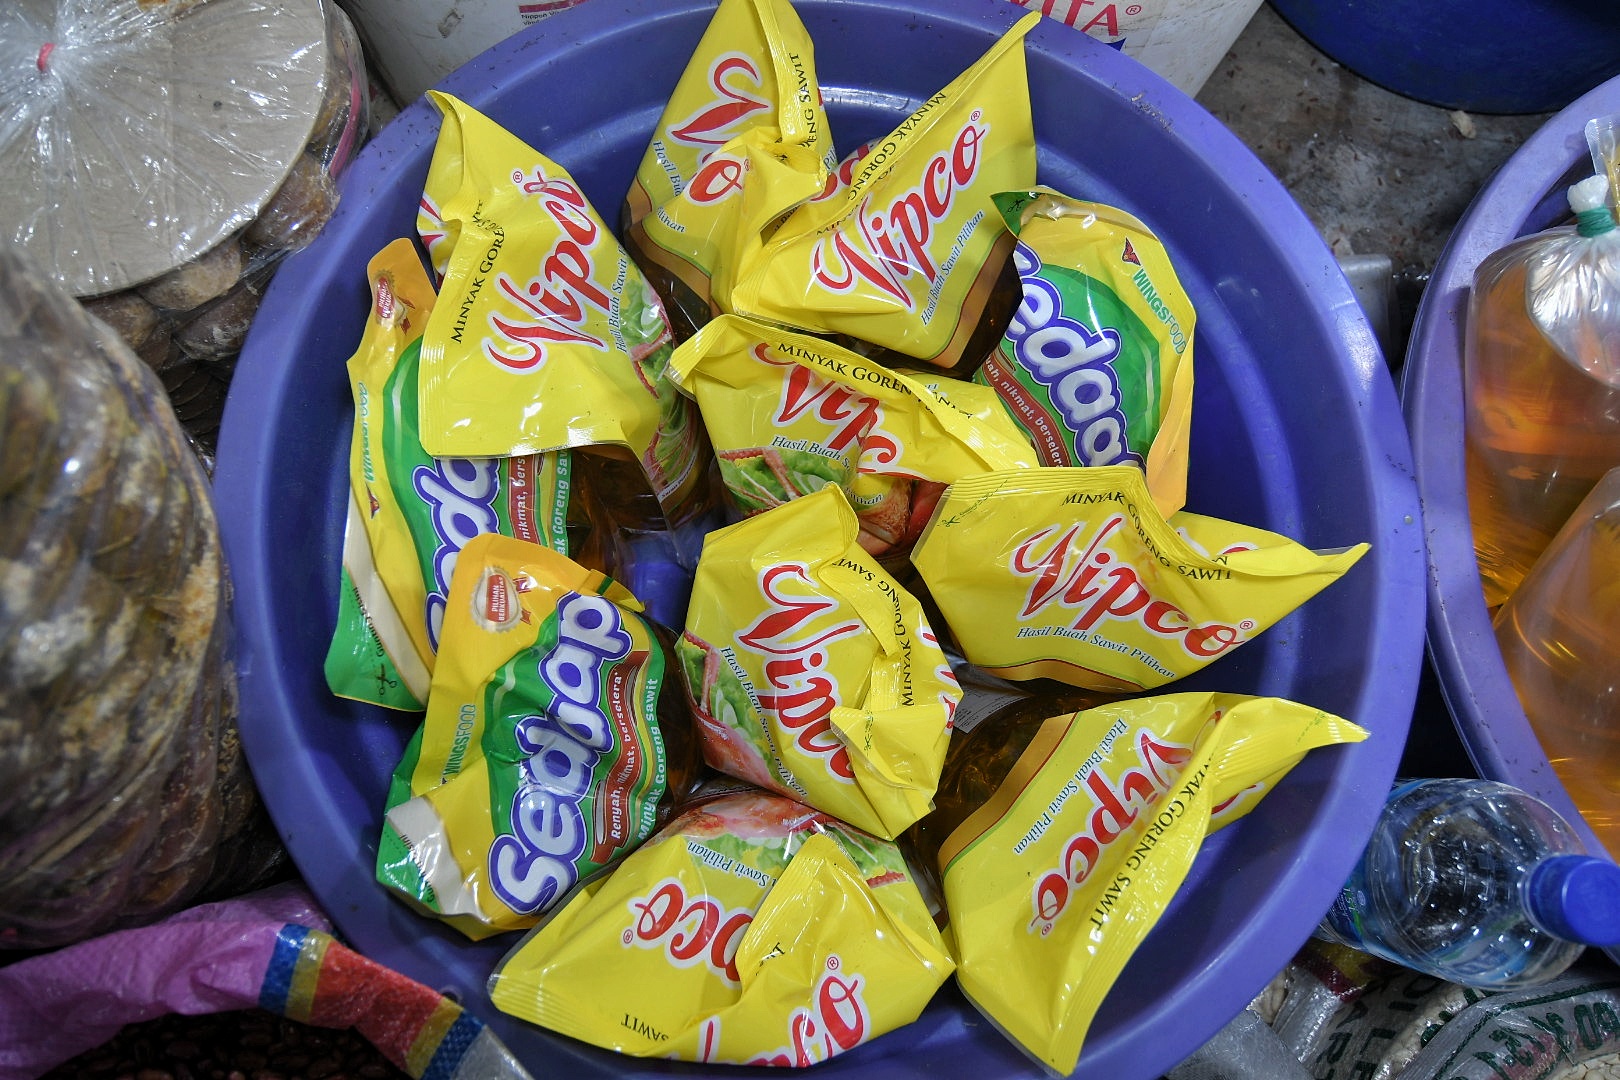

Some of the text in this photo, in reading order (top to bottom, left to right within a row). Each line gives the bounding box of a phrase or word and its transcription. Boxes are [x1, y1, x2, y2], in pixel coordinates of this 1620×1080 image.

[1010, 0, 1118, 36] ITA
[789, 52, 812, 103] SAWIT
[897, 92, 947, 140] MINYAK
[653, 140, 682, 197] Hasil Bua
[657, 206, 685, 232] ilihan
[813, 125, 986, 308] Vipco
[451, 275, 485, 344] MINYAK
[479, 228, 505, 275] GORE
[487, 170, 604, 369] Vipco
[612, 258, 627, 294] Sawit
[921, 294, 935, 325] Hasil
[941, 249, 960, 276] Sawit
[957, 210, 985, 247] Pilihan
[609, 296, 620, 328] Buah
[1132, 267, 1188, 356] WINGSFOOD
[778, 342, 912, 395] MINYAK GOREN
[771, 434, 842, 461] Hasil Buah
[552, 485, 571, 534] Goreng
[1061, 491, 1126, 506] MINYAK
[1176, 564, 1232, 582] SAWIT
[491, 585, 500, 612] PILIHAN
[1014, 516, 1250, 658] Vipco
[720, 646, 747, 681] Hasil
[742, 680, 763, 715] Buah
[902, 637, 915, 707] MINYAK
[1016, 625, 1176, 680] Hasil Buah Sawit Pilihan
[443, 704, 477, 775] WINGSFOOD
[637, 677, 667, 843] Minyak Goreng Sawit
[1014, 718, 1127, 855] Hasil Buah Sawit Pilihan
[687, 840, 771, 888] Sawit Pilihan
[1125, 799, 1186, 871] GORENG
[635, 883, 752, 982] pco
[1089, 871, 1131, 931] SAWIT
